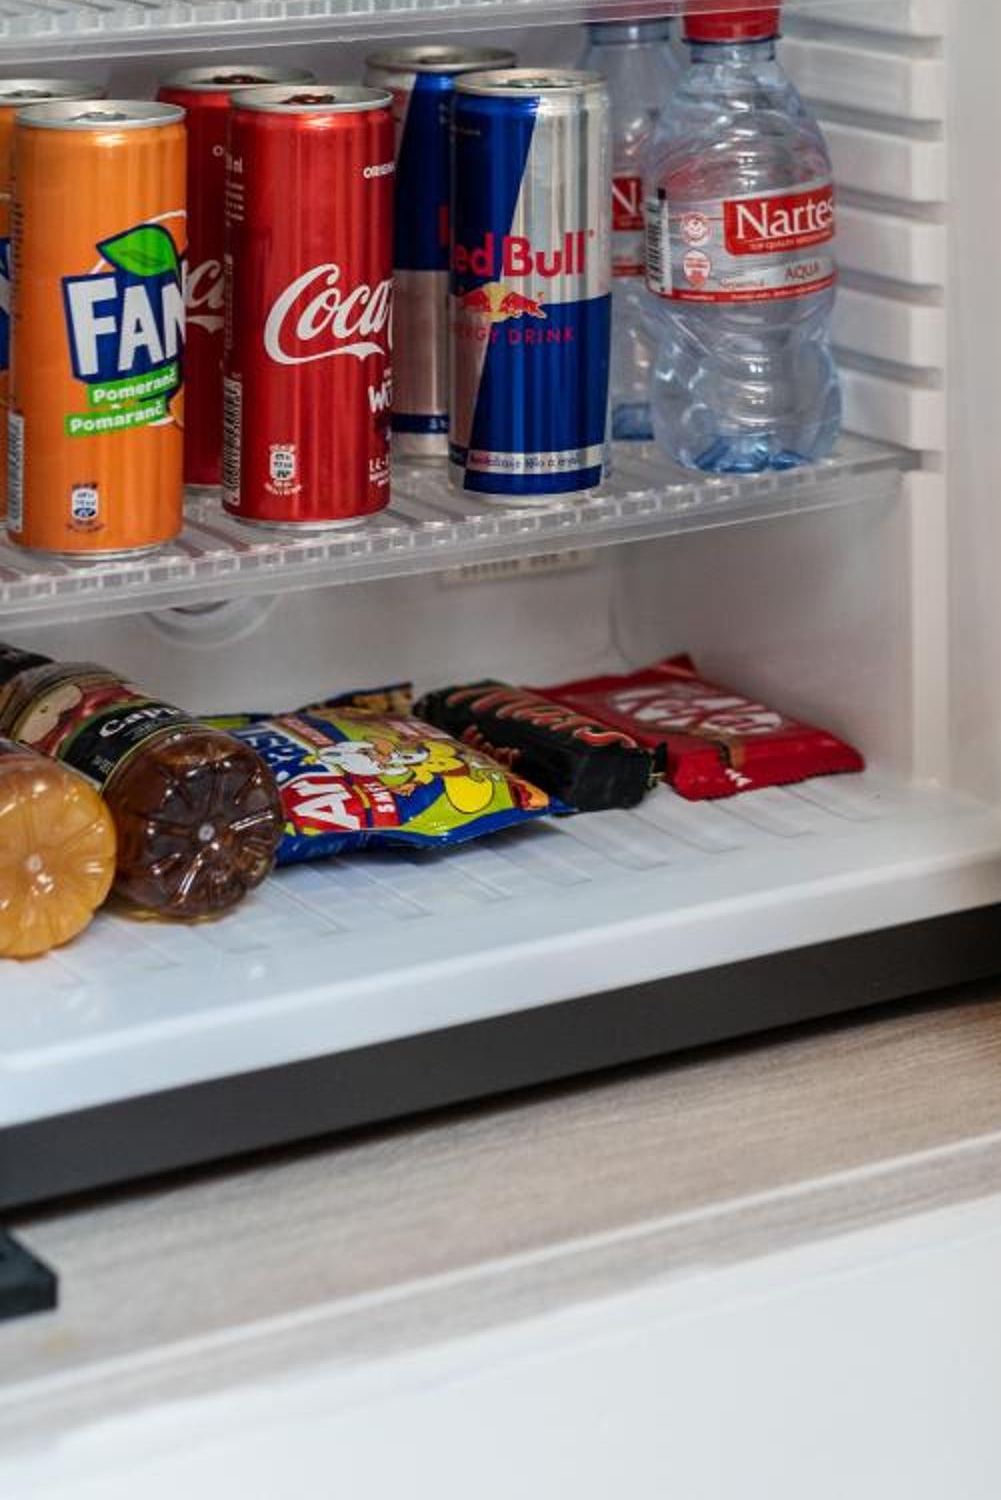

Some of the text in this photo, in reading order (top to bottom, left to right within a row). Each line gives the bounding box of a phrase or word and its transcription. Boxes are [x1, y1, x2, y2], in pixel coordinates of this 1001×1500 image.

[504, 229, 586, 279] Bull
[264, 263, 389, 365] Coca
[507, 326, 574, 345] DRINK
